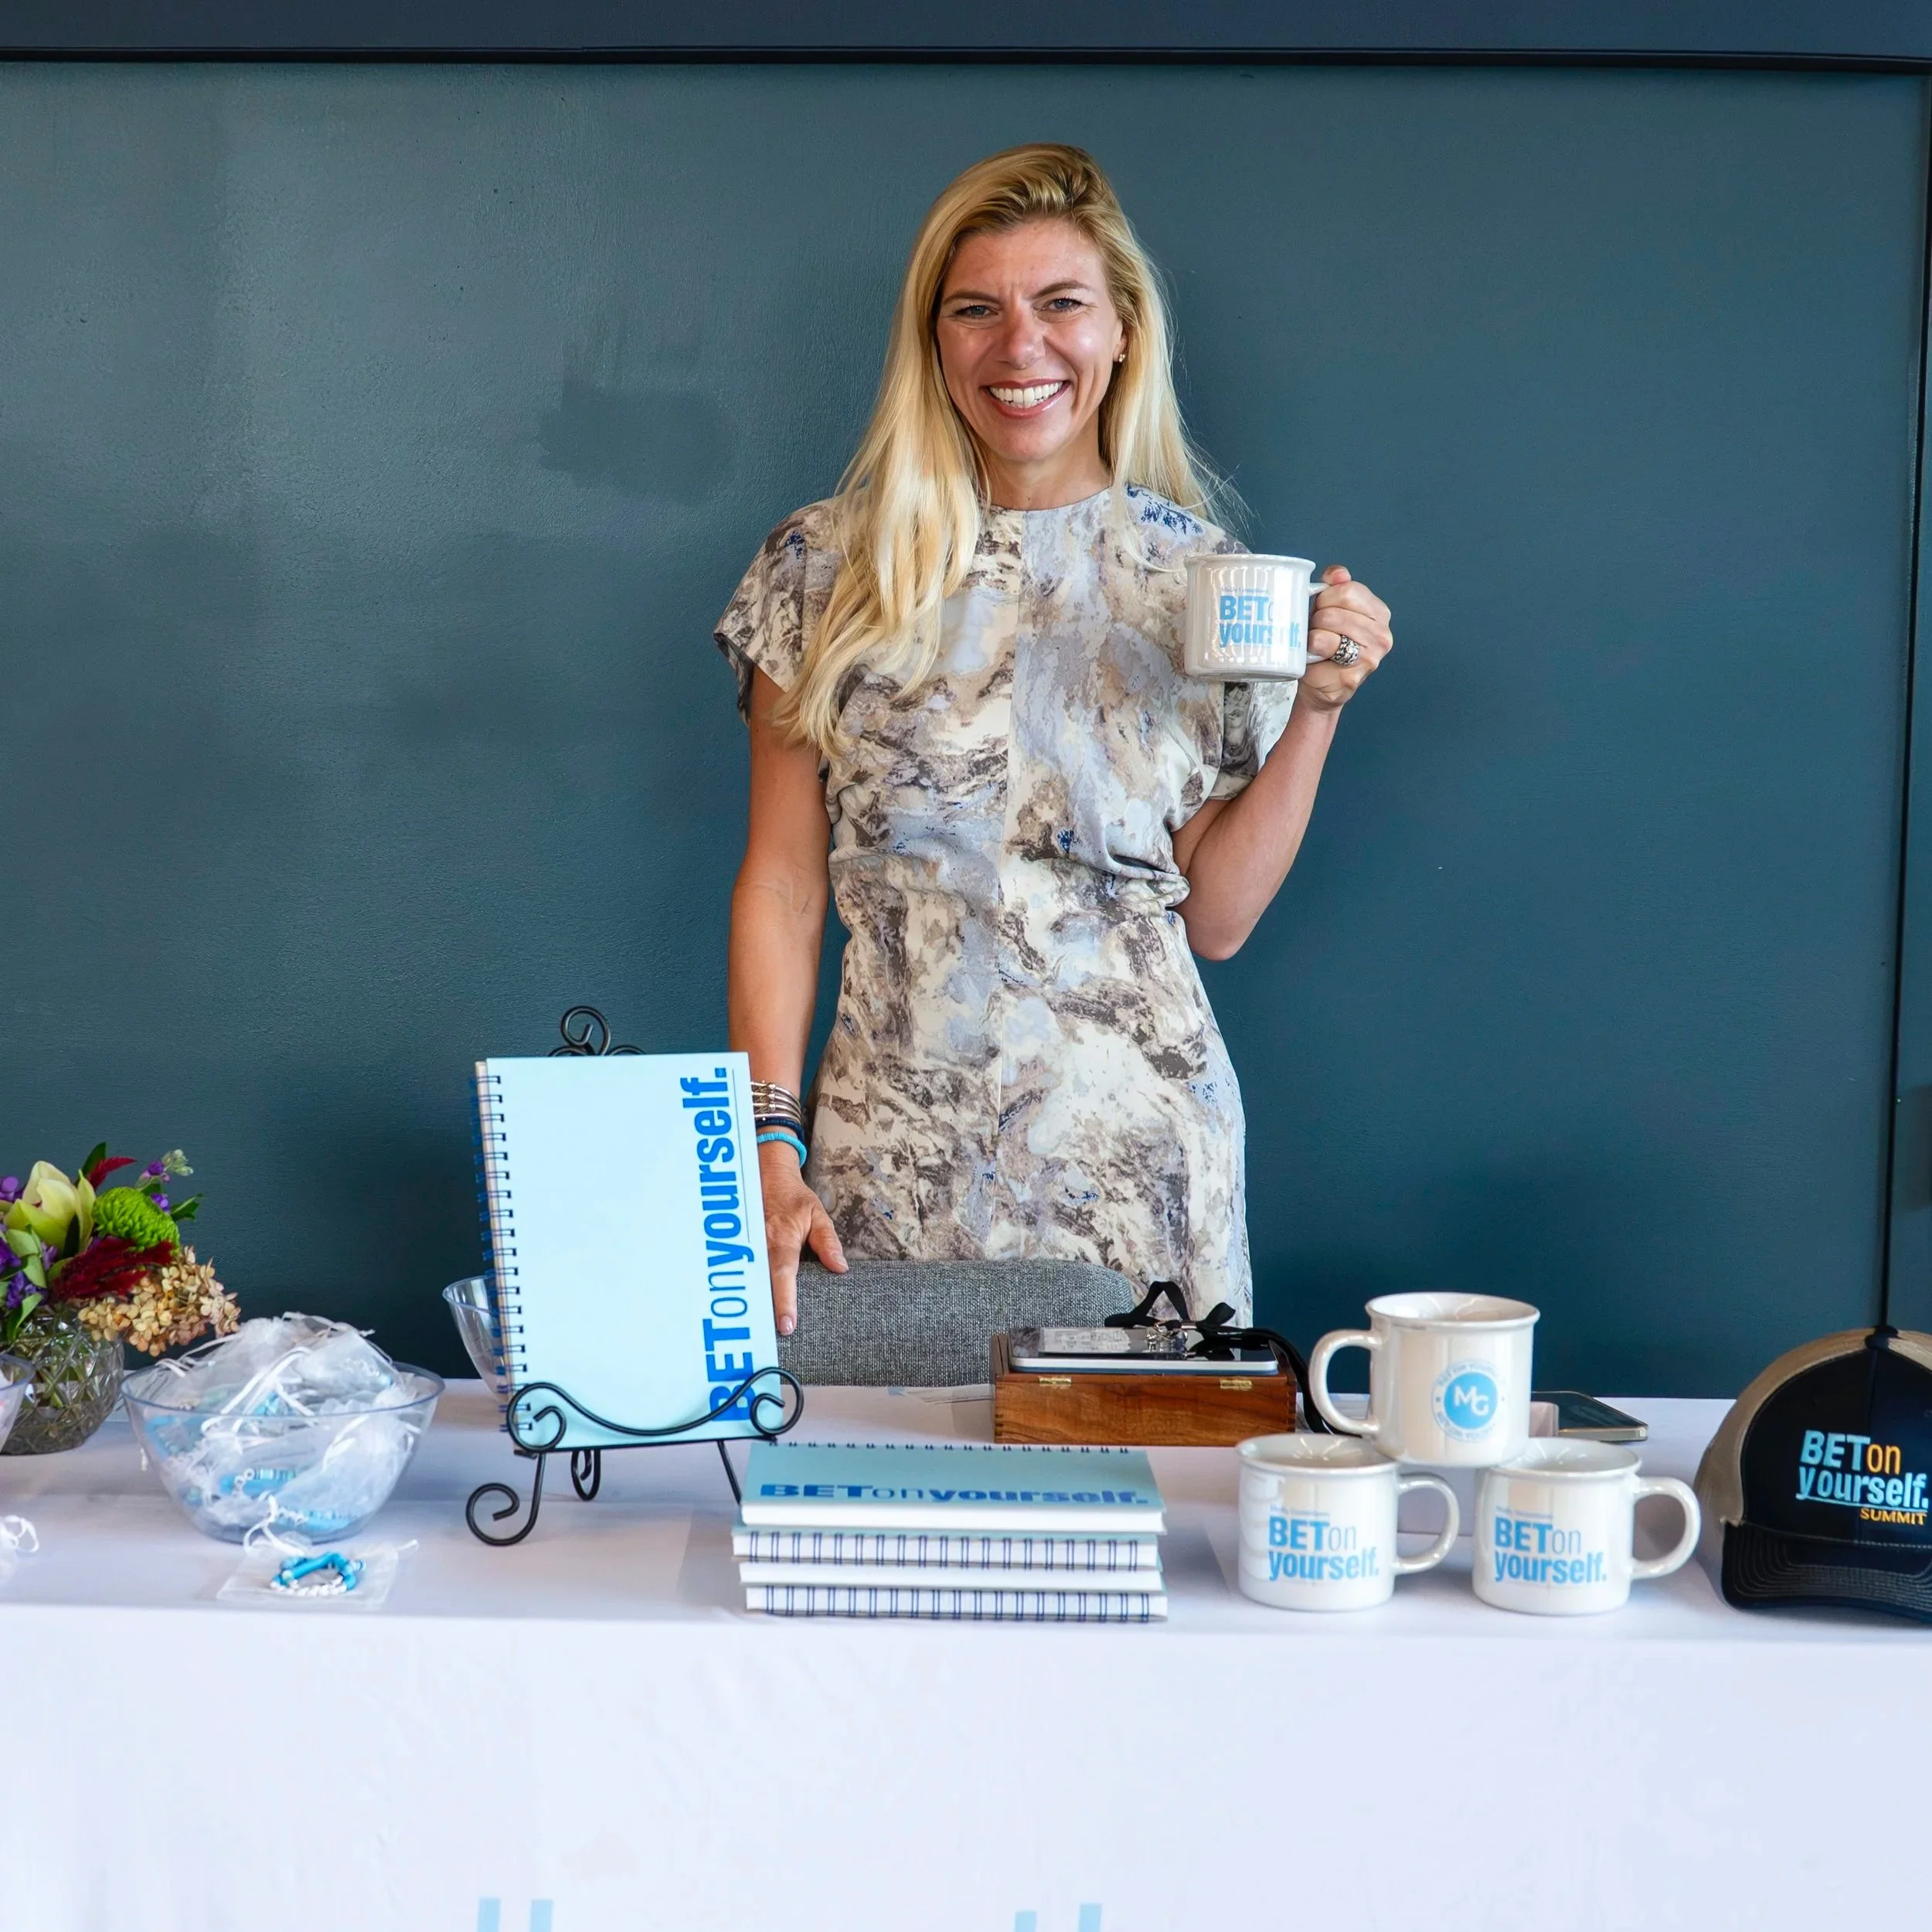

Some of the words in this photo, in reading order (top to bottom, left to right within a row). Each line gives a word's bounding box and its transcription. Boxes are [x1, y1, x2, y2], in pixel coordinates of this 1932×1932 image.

[1454, 1385, 1489, 1416] MG
[1796, 1466, 1929, 1509] yourself.
[1859, 1508, 1927, 1526] SUMMIT
[1269, 1546, 1379, 1582] yourself.
[1495, 1551, 1607, 1583] yourself.
